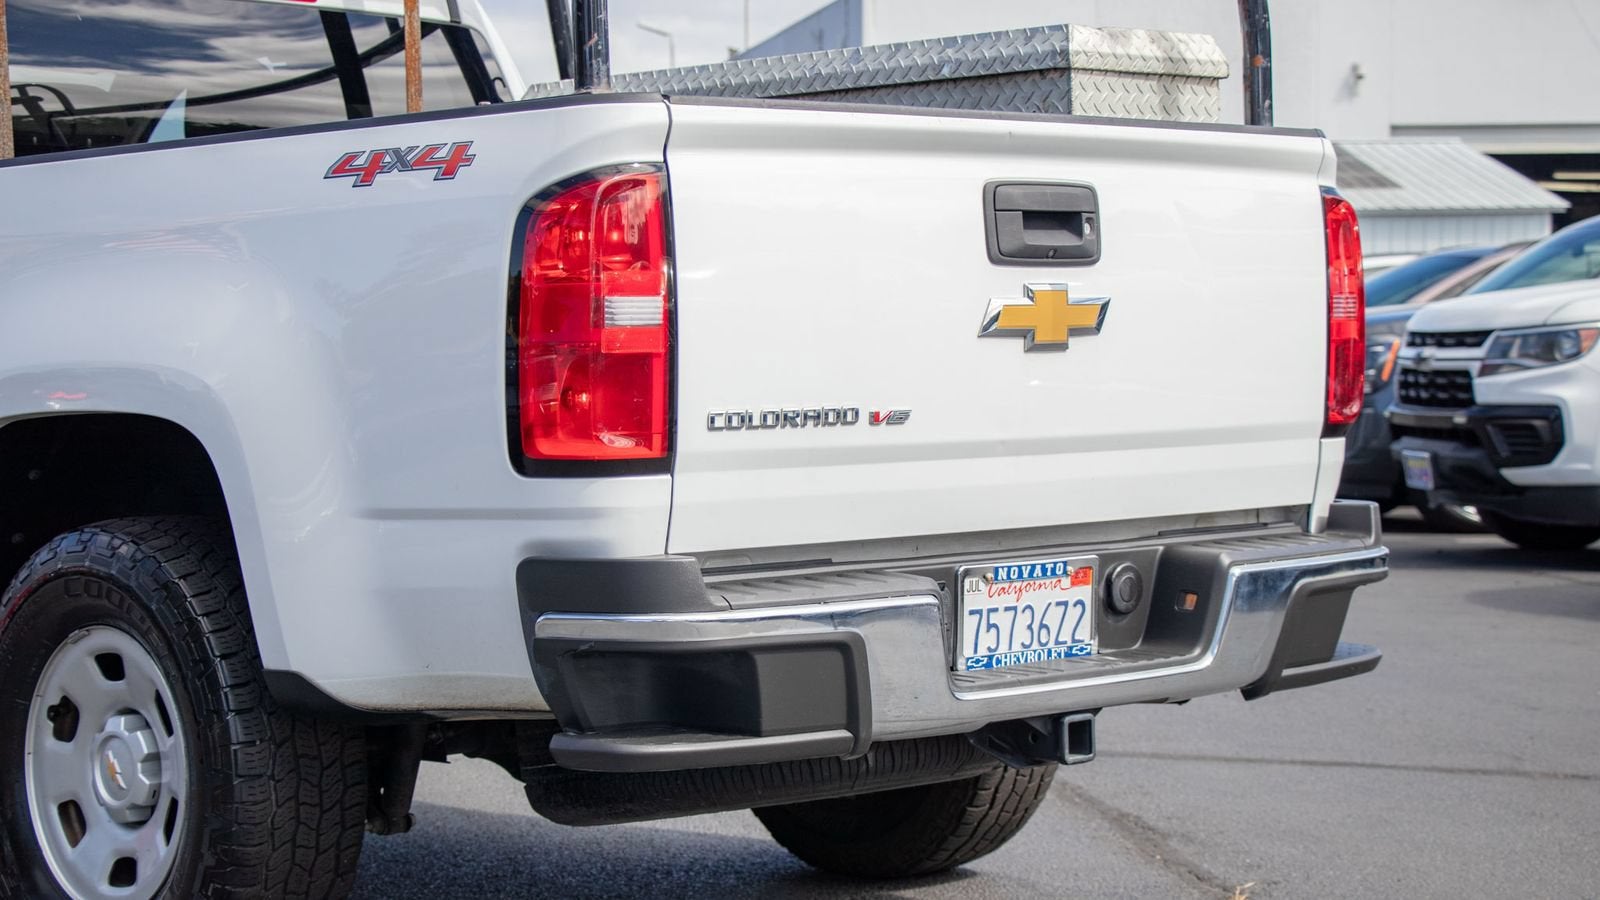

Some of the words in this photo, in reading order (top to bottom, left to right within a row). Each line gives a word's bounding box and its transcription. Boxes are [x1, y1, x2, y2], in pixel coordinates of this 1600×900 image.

[707, 406, 860, 432] COLORADO
[868, 409, 913, 426] V6
[997, 561, 1065, 581] NOVATO
[966, 579, 982, 594] JUL
[987, 578, 1073, 603] California
[991, 646, 1068, 669] CHEVROLET
